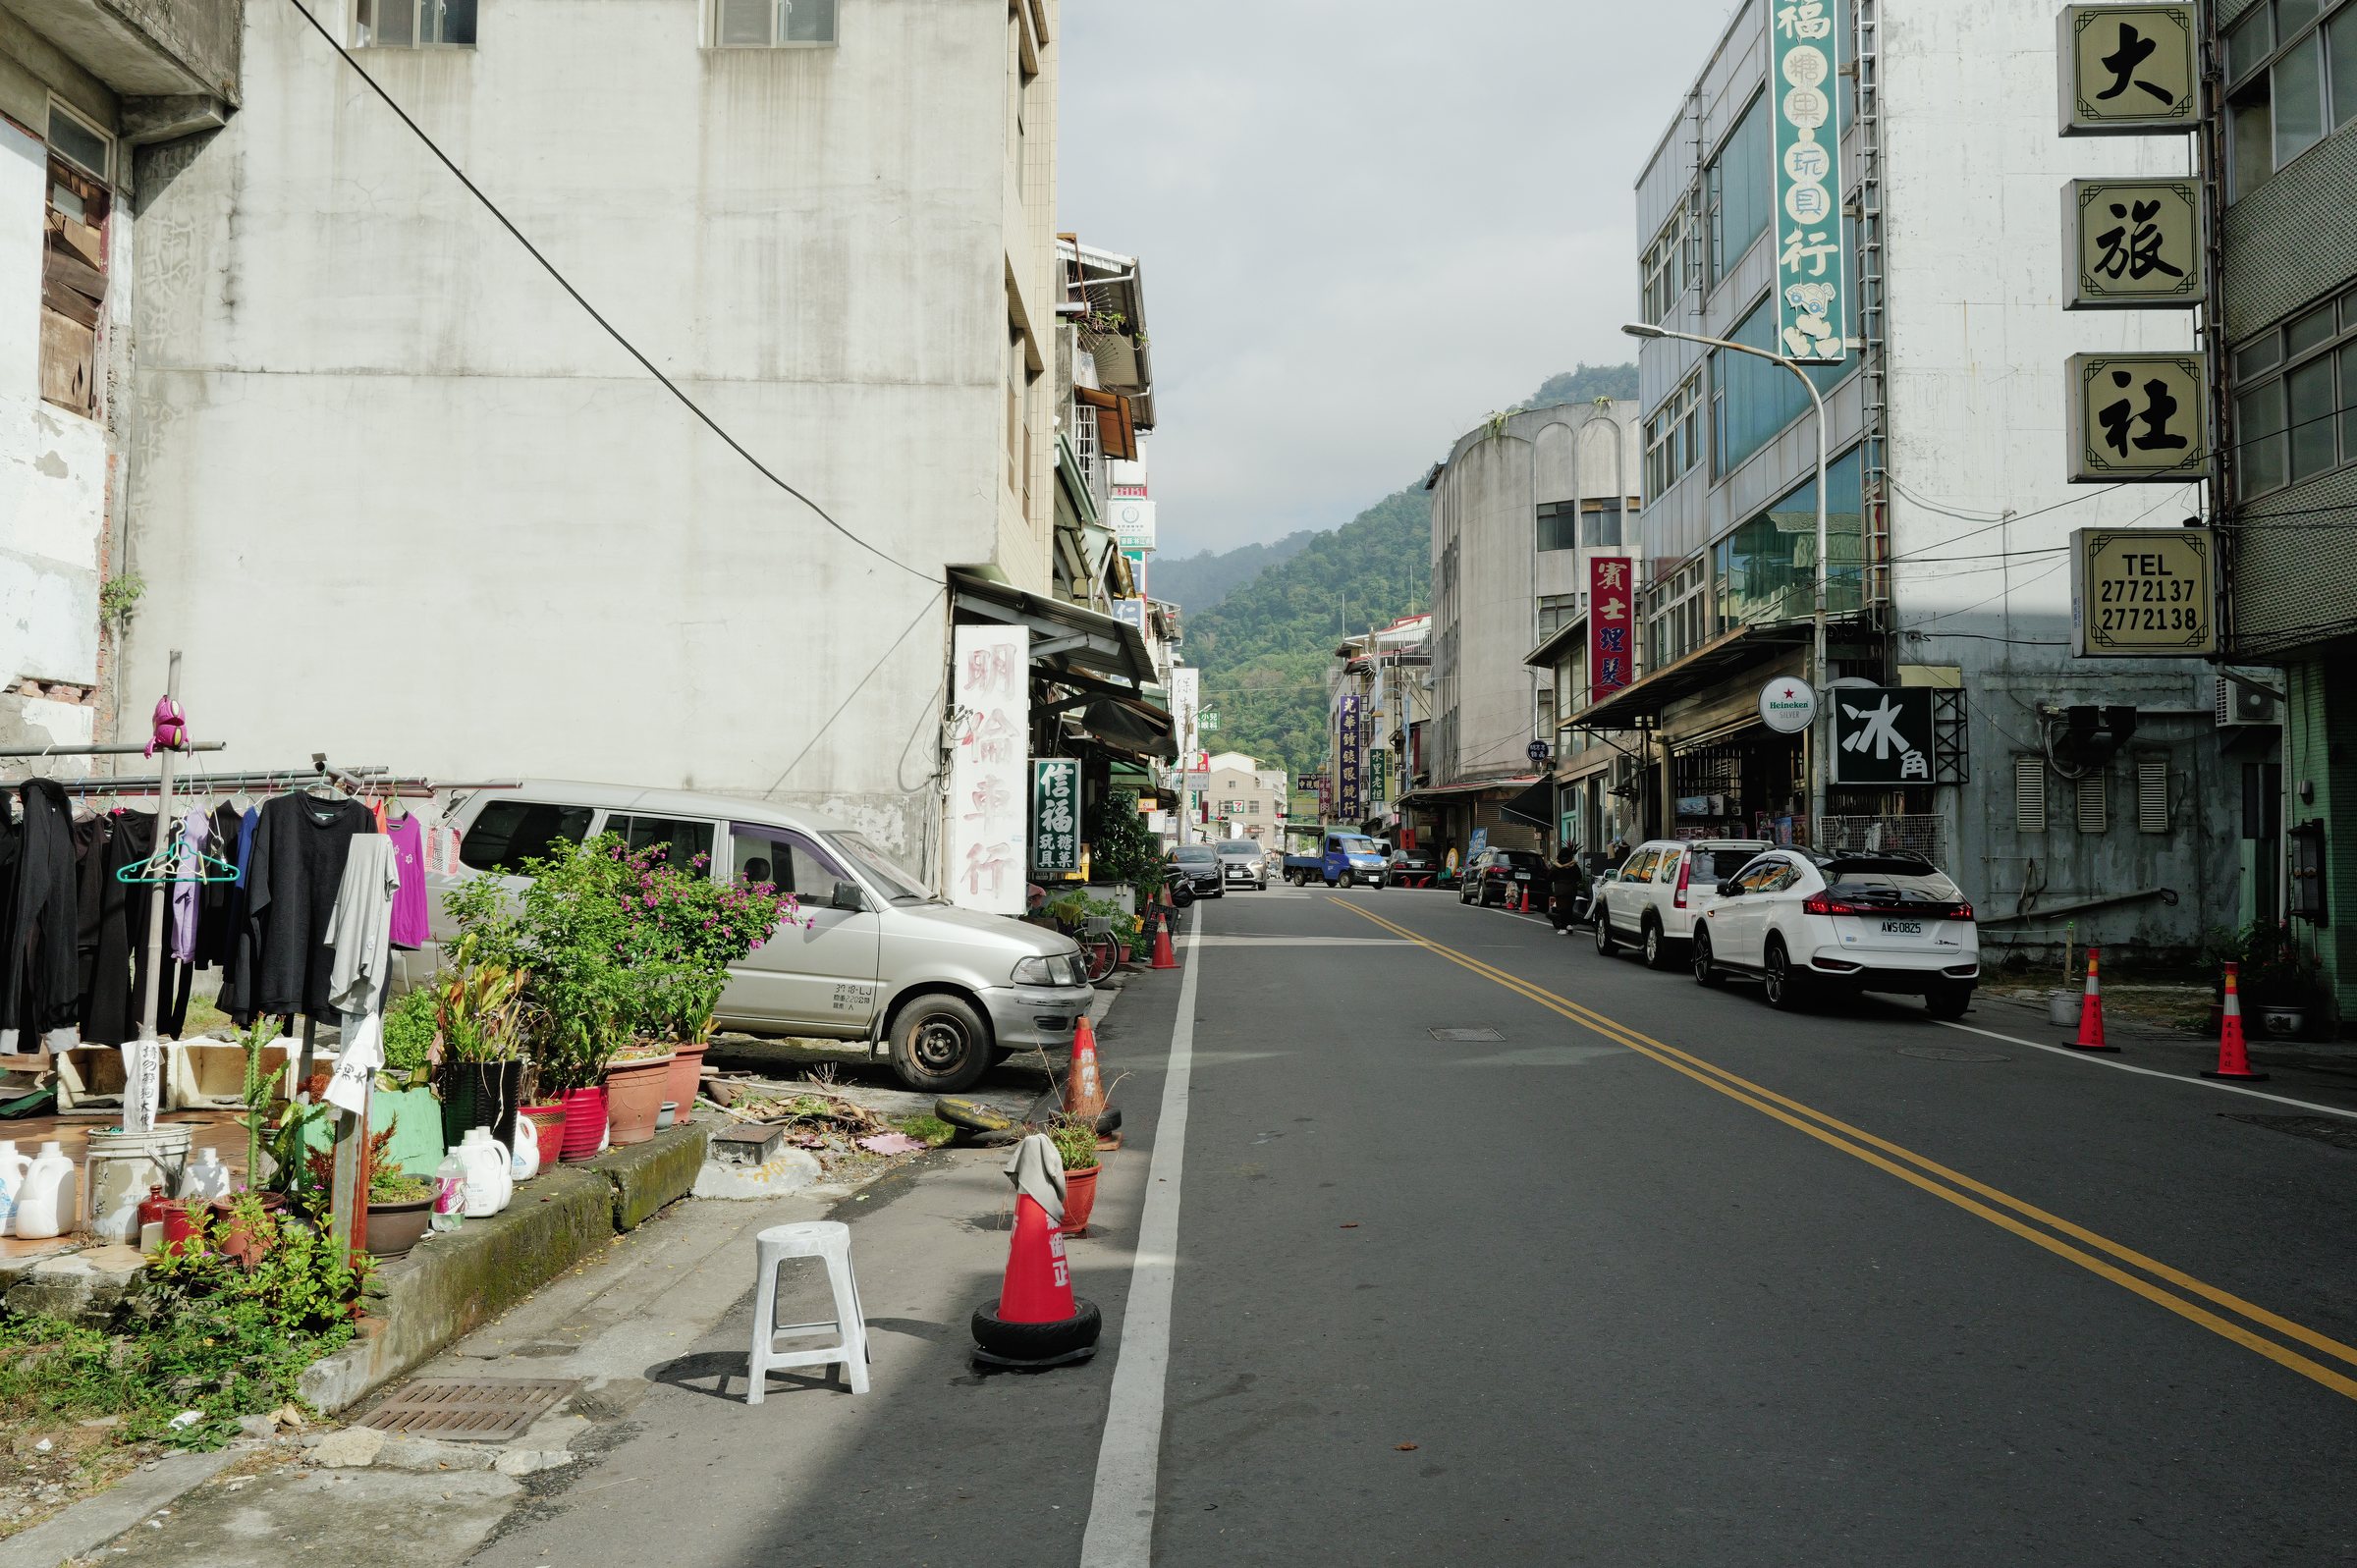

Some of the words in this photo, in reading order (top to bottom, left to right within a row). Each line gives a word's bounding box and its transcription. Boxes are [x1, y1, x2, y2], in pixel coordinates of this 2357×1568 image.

[2122, 555, 2172, 576] TEL
[2102, 579, 2195, 604] 2772137
[2103, 606, 2197, 632] 2772138
[1770, 701, 1809, 710] Heineken
[1779, 710, 1800, 720] SILVER
[1841, 693, 1929, 779] 冰角
[1343, 697, 1357, 816] 光華鐘錶眼鏡行
[1039, 763, 1075, 833] 信福
[1039, 835, 1055, 868] 玩具
[1881, 921, 1922, 934] AWS-0825
